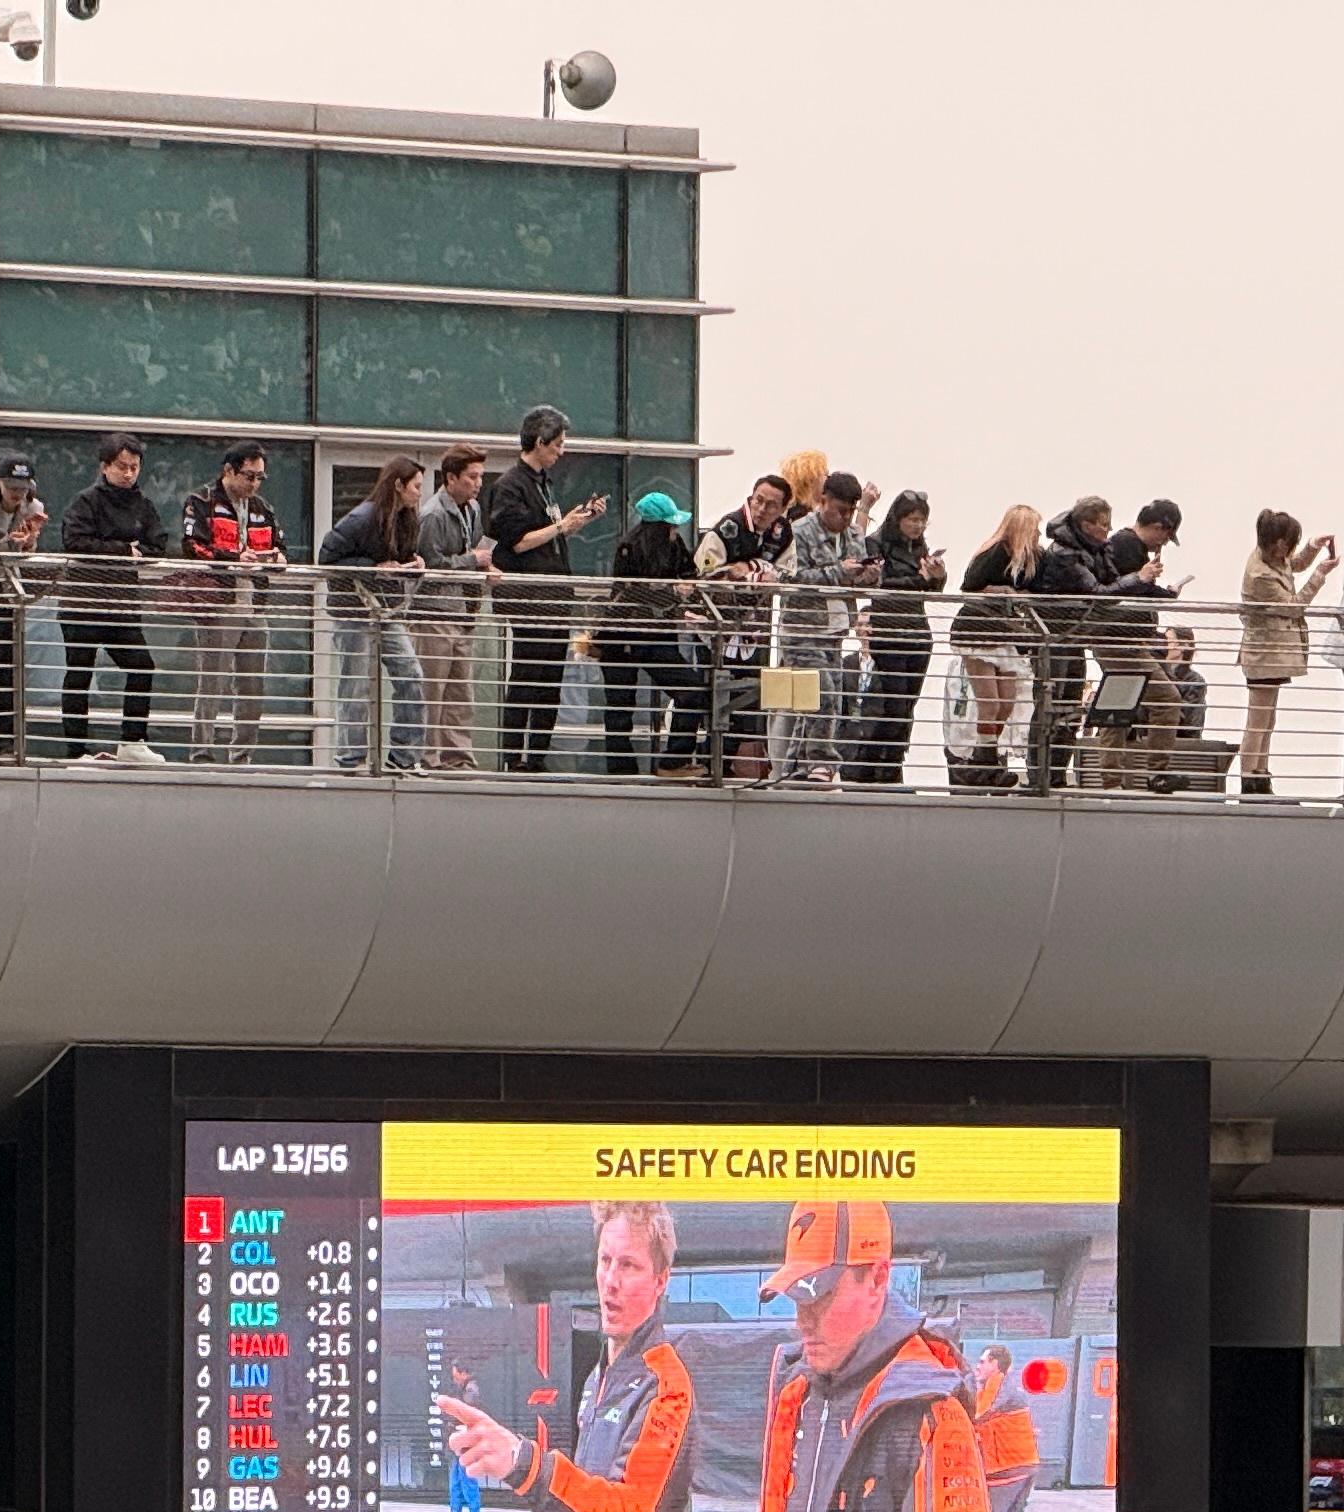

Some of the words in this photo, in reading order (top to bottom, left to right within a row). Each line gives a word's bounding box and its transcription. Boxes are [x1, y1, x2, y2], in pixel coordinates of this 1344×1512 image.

[219, 1146, 264, 1171] LAP
[272, 1145, 348, 1175] 13/56
[596, 1149, 718, 1178] SAFETY
[726, 1149, 787, 1178] CAR
[796, 1150, 915, 1178] ENDING
[199, 1211, 211, 1234] 1
[229, 1209, 285, 1235] ANT
[198, 1242, 213, 1266] 2
[229, 1240, 276, 1266] COL
[307, 1240, 352, 1265] +0.8
[198, 1272, 213, 1296] 3
[229, 1271, 280, 1296] OCO
[307, 1271, 352, 1295] +1.4
[197, 1303, 211, 1327] 4
[230, 1301, 278, 1327] RUS
[307, 1302, 351, 1326] +2.6
[197, 1334, 211, 1357] 5
[230, 1333, 289, 1357] HAM
[306, 1332, 351, 1357] +3.6
[197, 1365, 211, 1388] 6
[229, 1363, 269, 1388] LIN
[306, 1363, 350, 1387] +5.1
[197, 1396, 211, 1419] 7
[228, 1394, 273, 1419] LEC
[306, 1394, 350, 1417] +7.2
[197, 1427, 211, 1450] 8
[228, 1424, 279, 1449] HUL
[306, 1424, 351, 1449] +7.6
[197, 1457, 211, 1480] 9
[228, 1455, 279, 1480] GAS
[306, 1454, 351, 1479] +9.4
[190, 1488, 216, 1511] 10
[228, 1486, 278, 1511] BEA
[305, 1485, 350, 1510] +9.9
